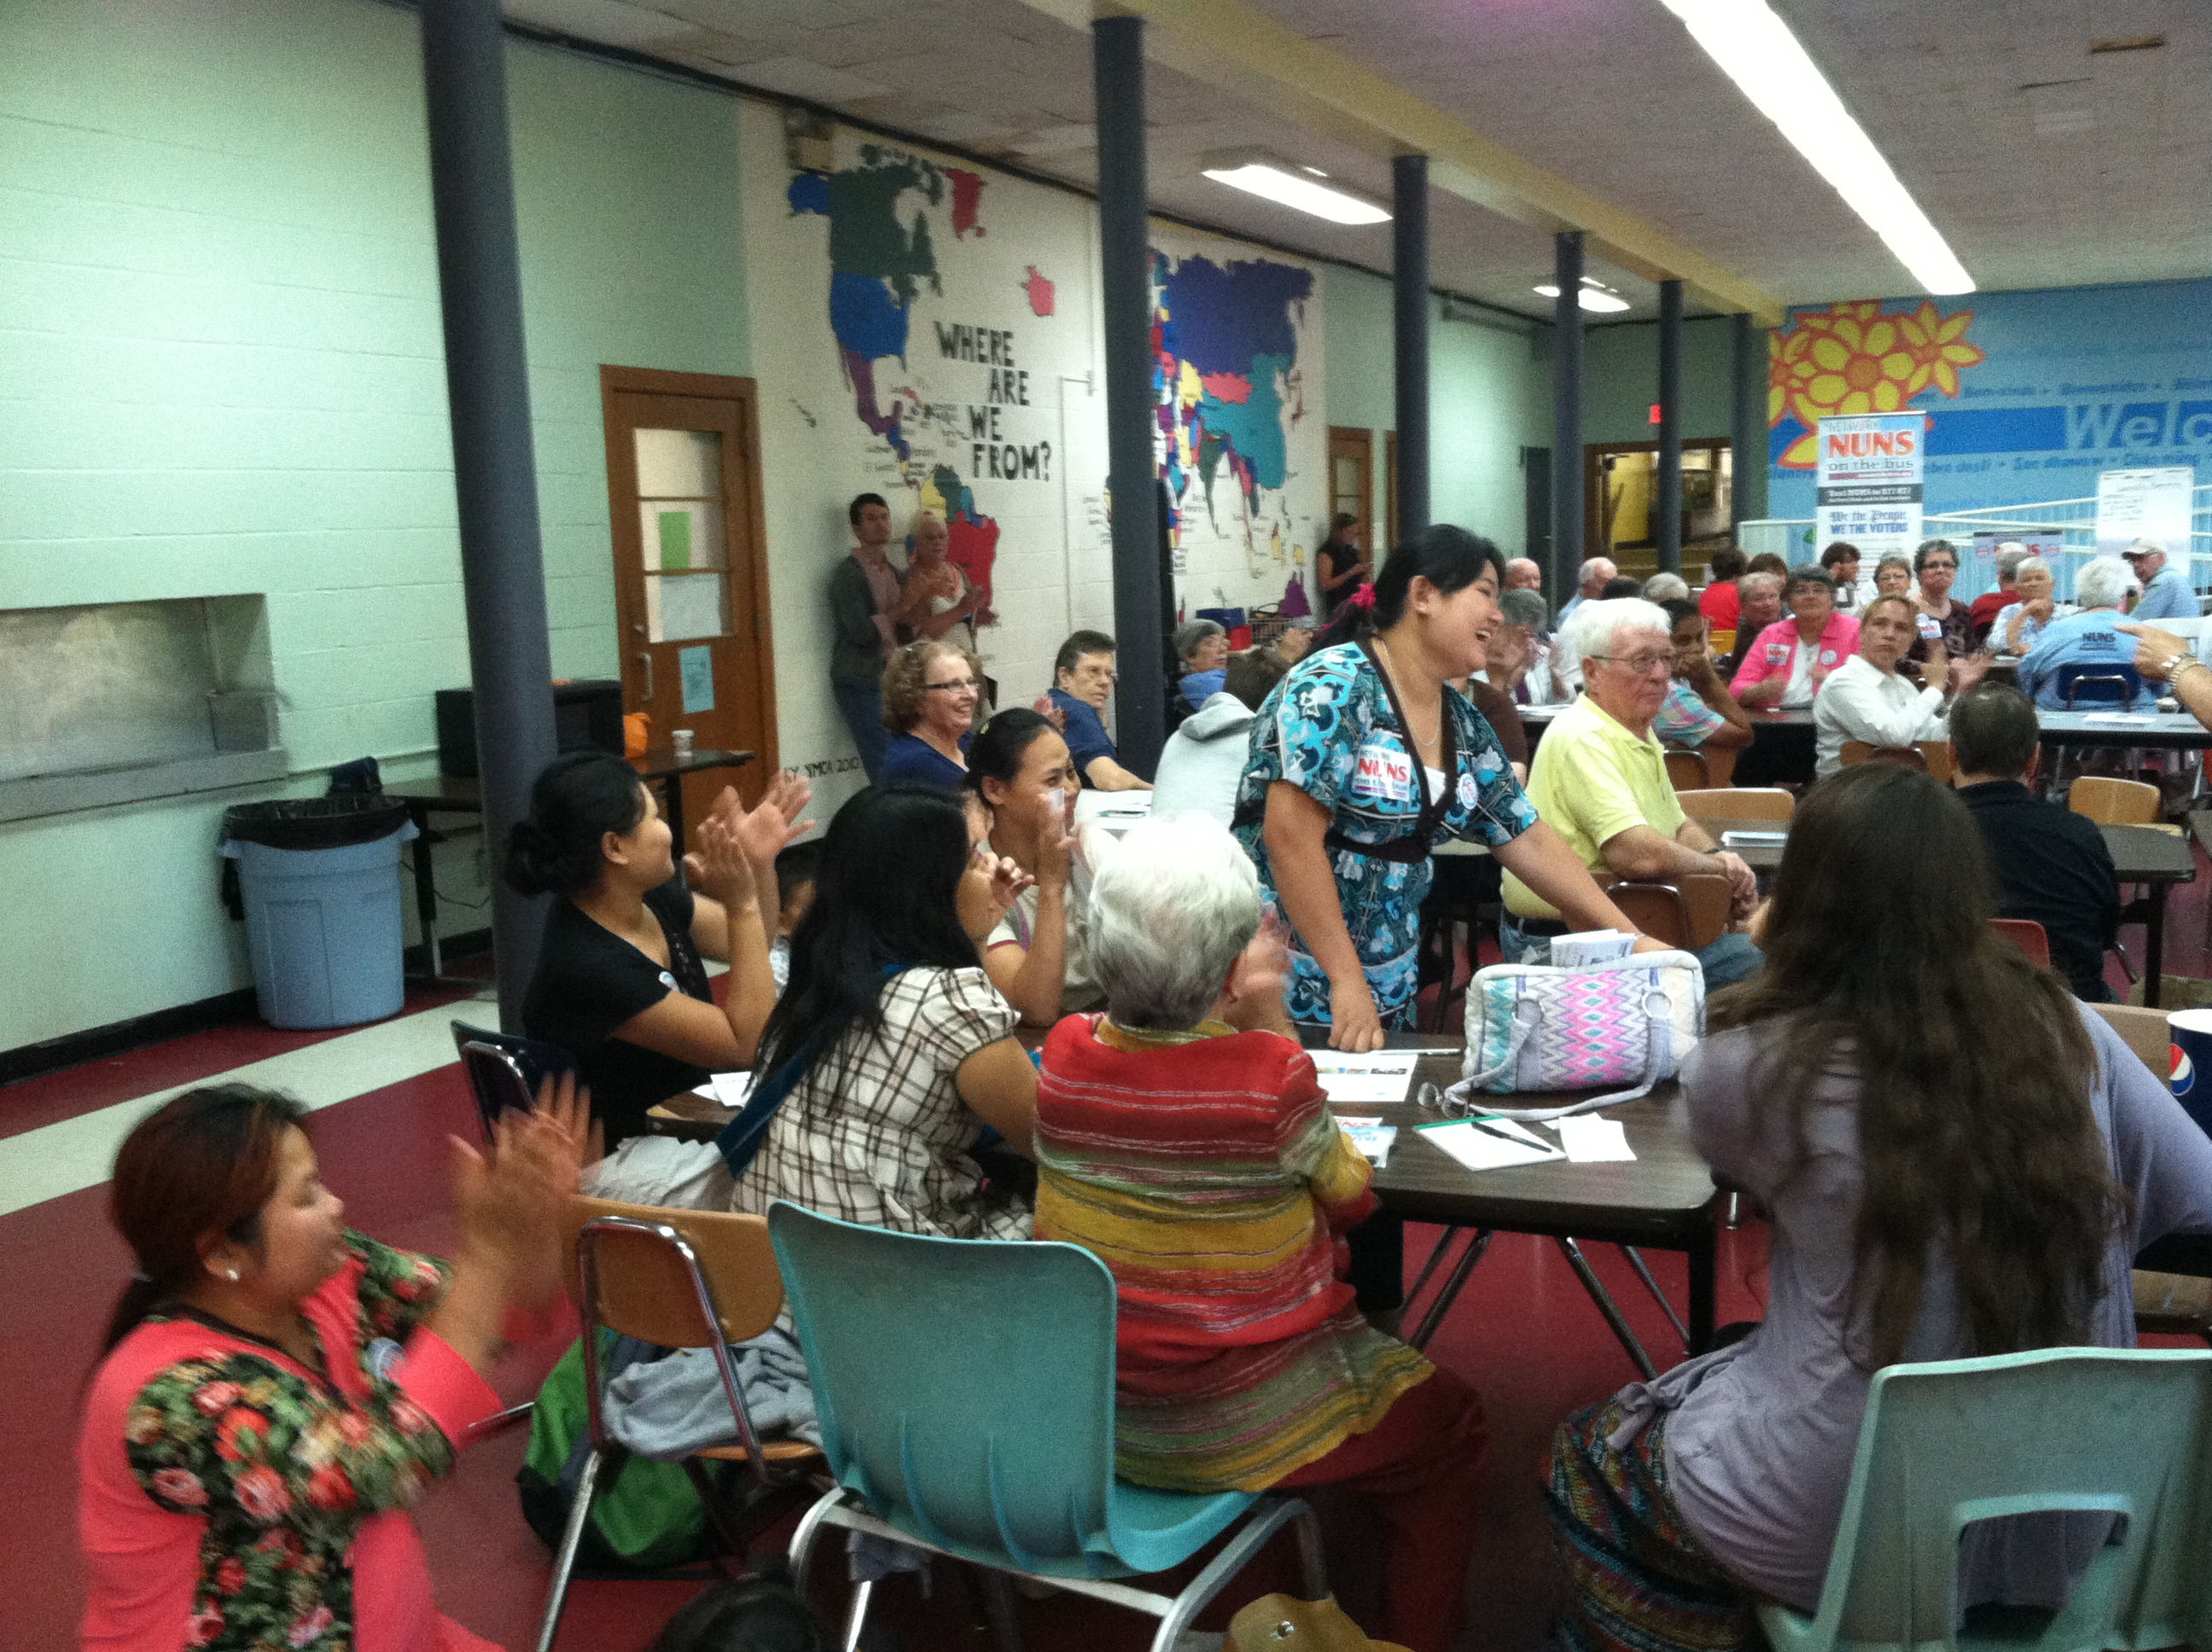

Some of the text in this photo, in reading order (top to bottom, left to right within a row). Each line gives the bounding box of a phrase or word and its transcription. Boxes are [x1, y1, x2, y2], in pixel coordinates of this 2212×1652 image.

[934, 321, 1015, 367] WHERE
[988, 368, 1030, 406] ARE
[969, 404, 1003, 442] WE
[1828, 431, 1914, 458] NUNS
[973, 440, 1051, 483] FROM?
[1828, 462, 1848, 471] on
[1854, 460, 1879, 470] the
[1884, 458, 1914, 469] bus
[1831, 524, 1848, 534] WE
[2082, 631, 2116, 643] NUNS
[1358, 758, 1408, 783] NUNS
